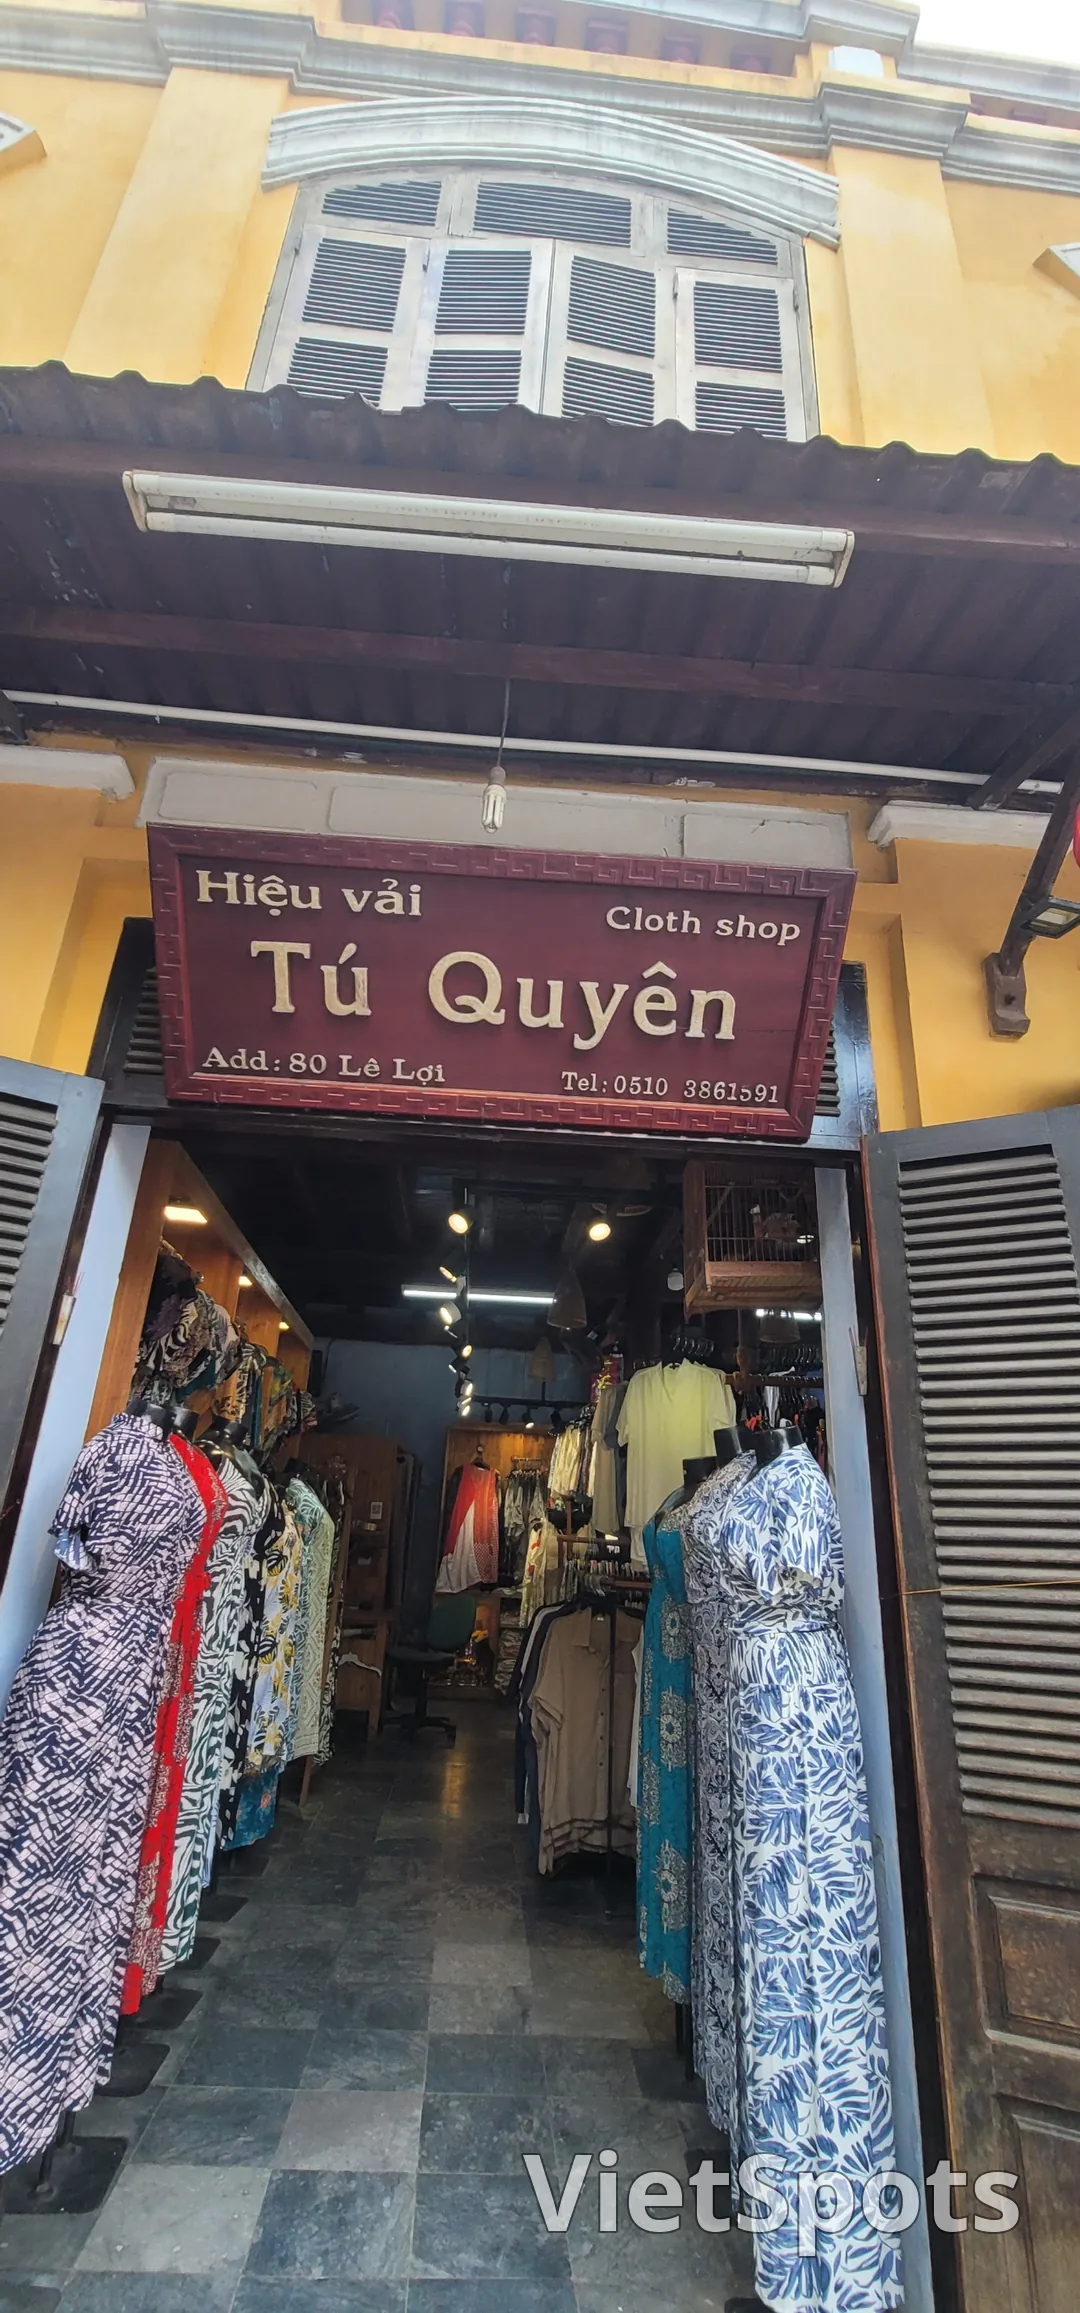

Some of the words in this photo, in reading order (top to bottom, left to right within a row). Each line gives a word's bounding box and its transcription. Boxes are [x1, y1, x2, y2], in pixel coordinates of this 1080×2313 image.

[195, 869, 323, 917] Hiệu
[340, 877, 423, 917] vải
[606, 906, 701, 935] Cloth
[714, 914, 801, 946] shop
[250, 940, 373, 1017] Tú
[428, 950, 737, 1052] Quyên
[288, 1052, 328, 1075] 80
[338, 1054, 381, 1078] Lê
[392, 1058, 446, 1085] Lợi
